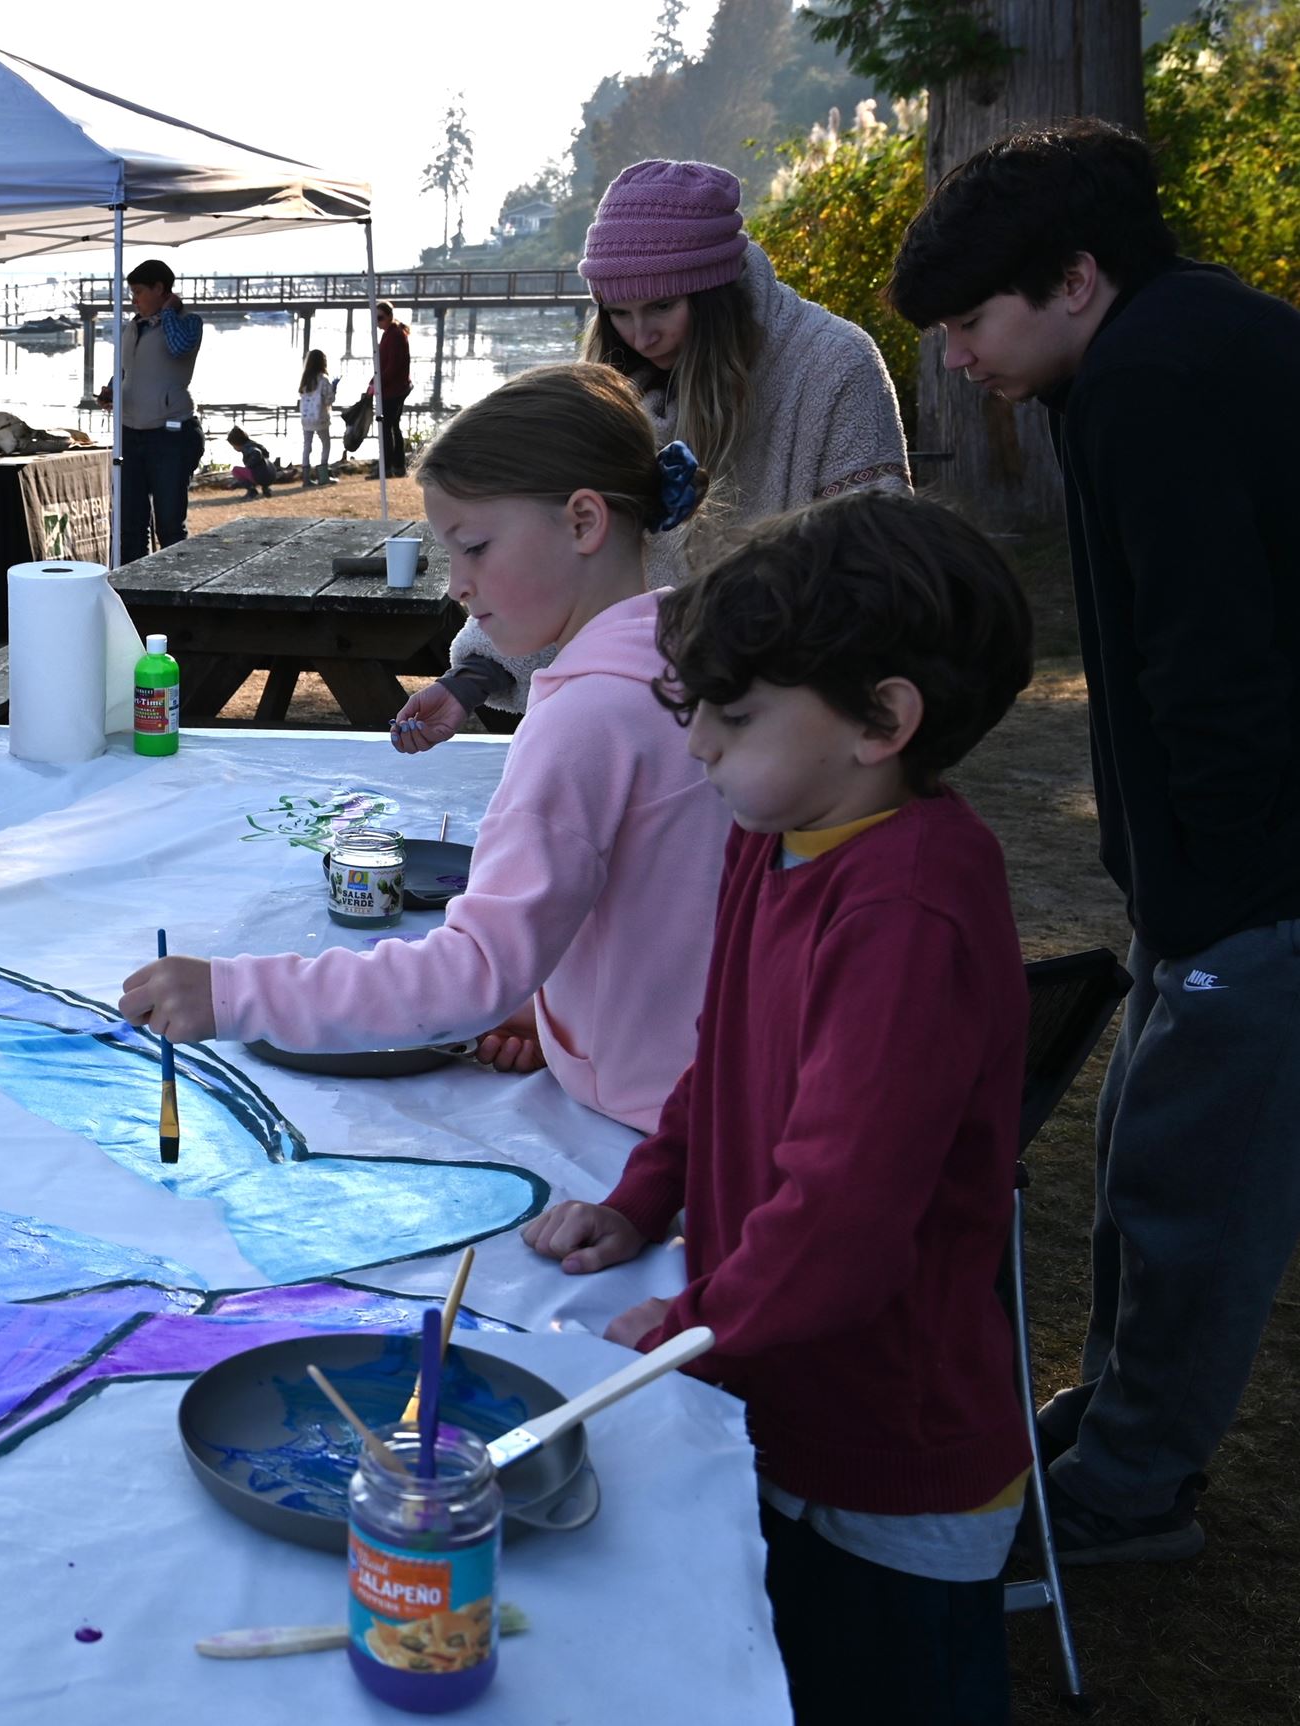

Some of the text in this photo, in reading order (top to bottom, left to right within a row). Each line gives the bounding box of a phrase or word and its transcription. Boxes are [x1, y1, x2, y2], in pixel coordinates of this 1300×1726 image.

[133, 698, 163, 706] rt-Time
[342, 890, 373, 899] SALSA
[341, 898, 374, 908] VERDE
[1187, 969, 1219, 987] NIKE
[358, 1565, 442, 1606] JALAPEÑO
